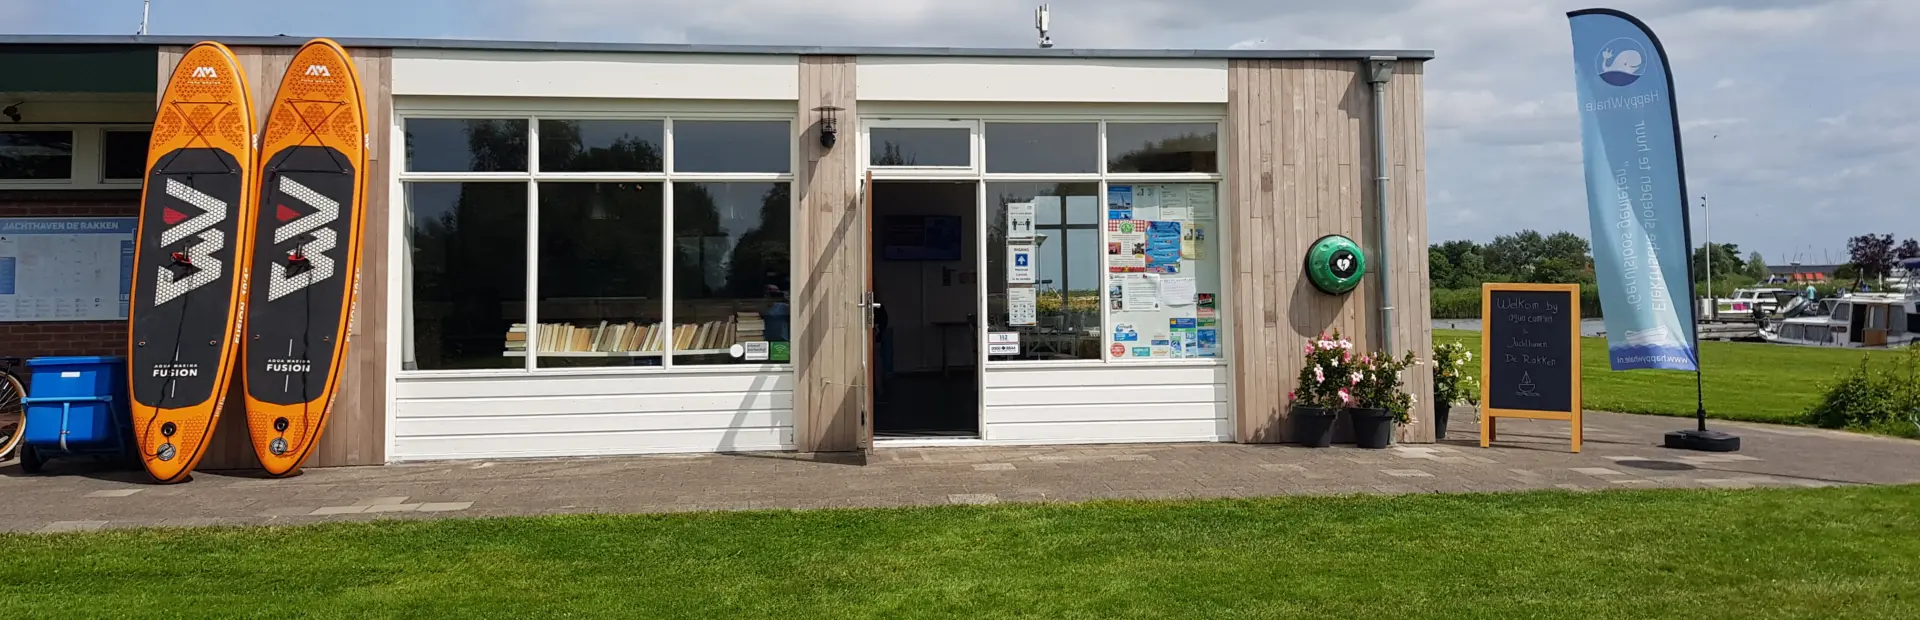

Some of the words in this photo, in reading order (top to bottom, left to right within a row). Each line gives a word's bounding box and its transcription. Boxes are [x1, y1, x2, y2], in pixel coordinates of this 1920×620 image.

[3, 222, 65, 230] JACHTHAVEN
[66, 221, 79, 229] DE
[80, 221, 119, 229] RAKKEN
[266, 364, 311, 372] FUSION
